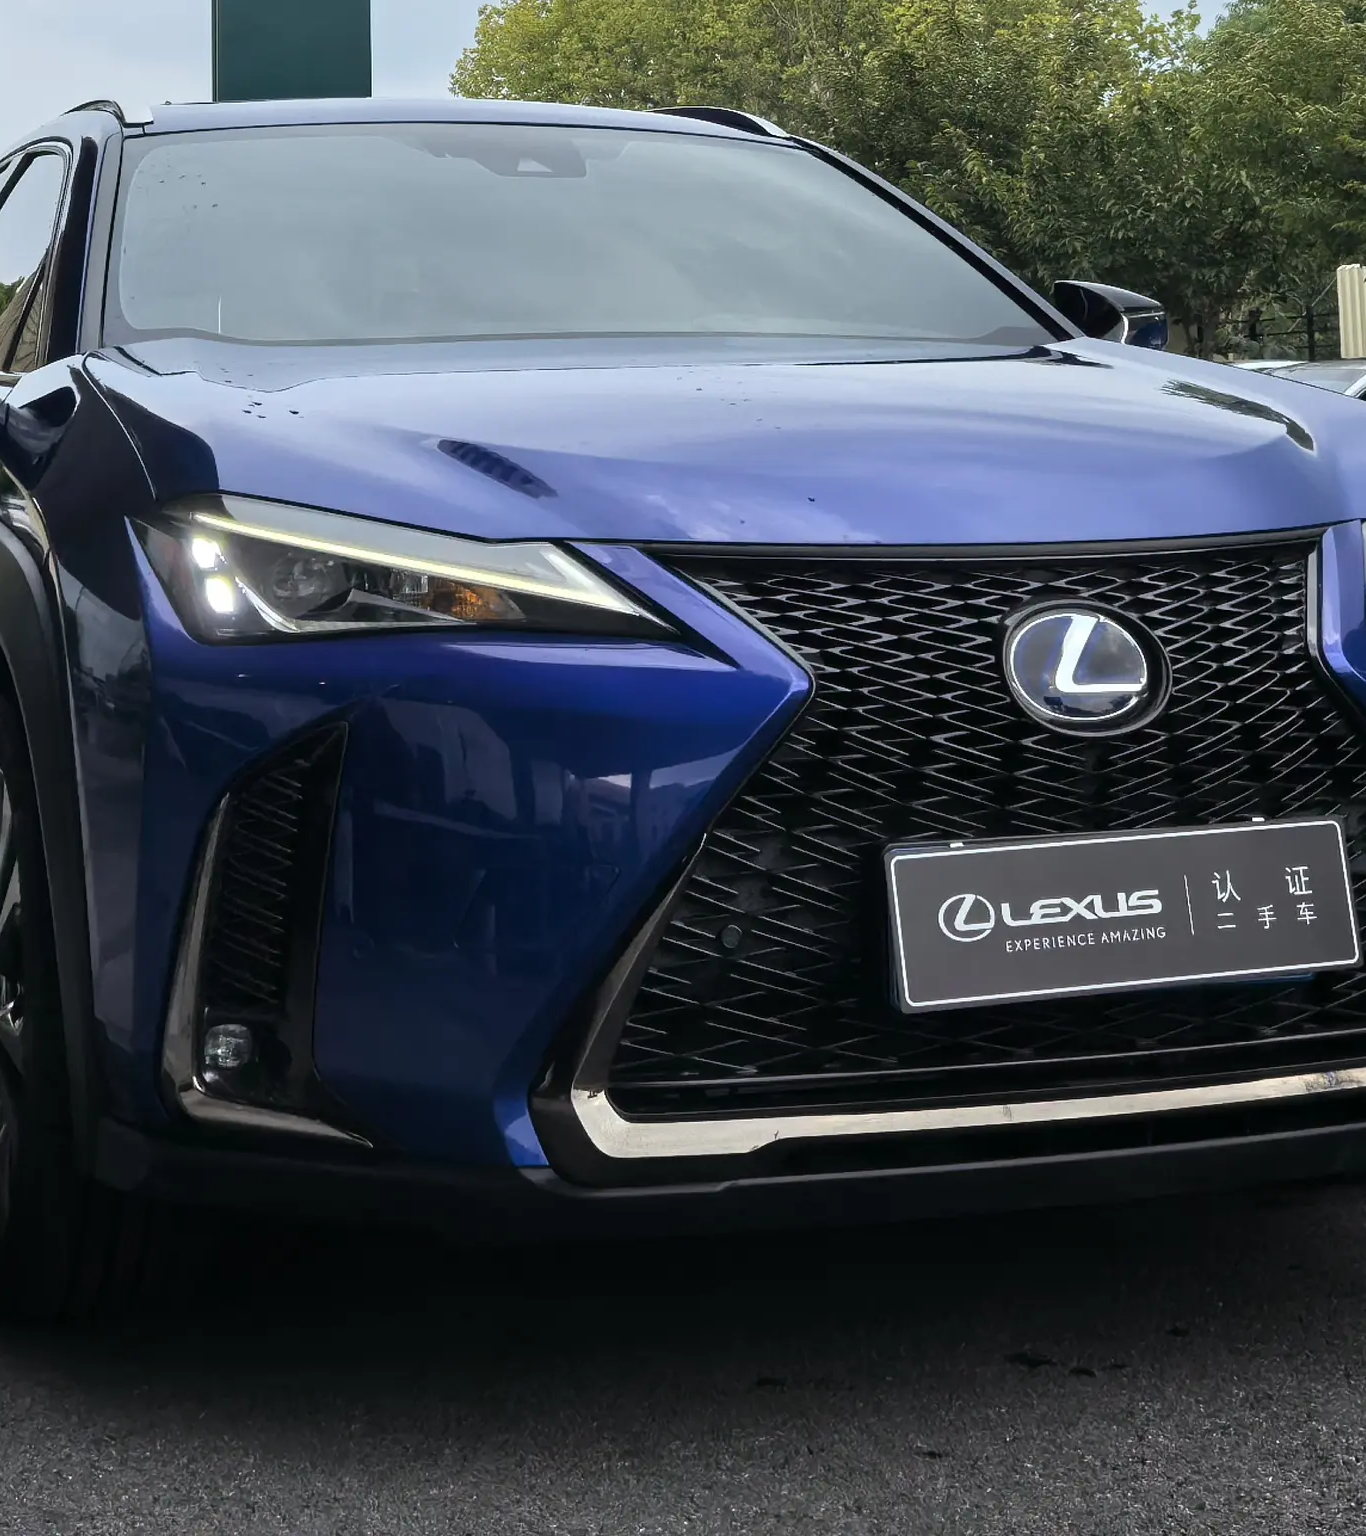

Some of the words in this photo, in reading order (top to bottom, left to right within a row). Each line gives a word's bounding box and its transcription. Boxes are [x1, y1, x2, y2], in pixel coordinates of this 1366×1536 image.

[1212, 866, 1313, 902] 认证
[1000, 889, 1163, 926] LEXUS
[1217, 902, 1318, 929] 二手车
[1005, 932, 1095, 952] EXPERIENCE
[1101, 926, 1167, 944] AMAZING
